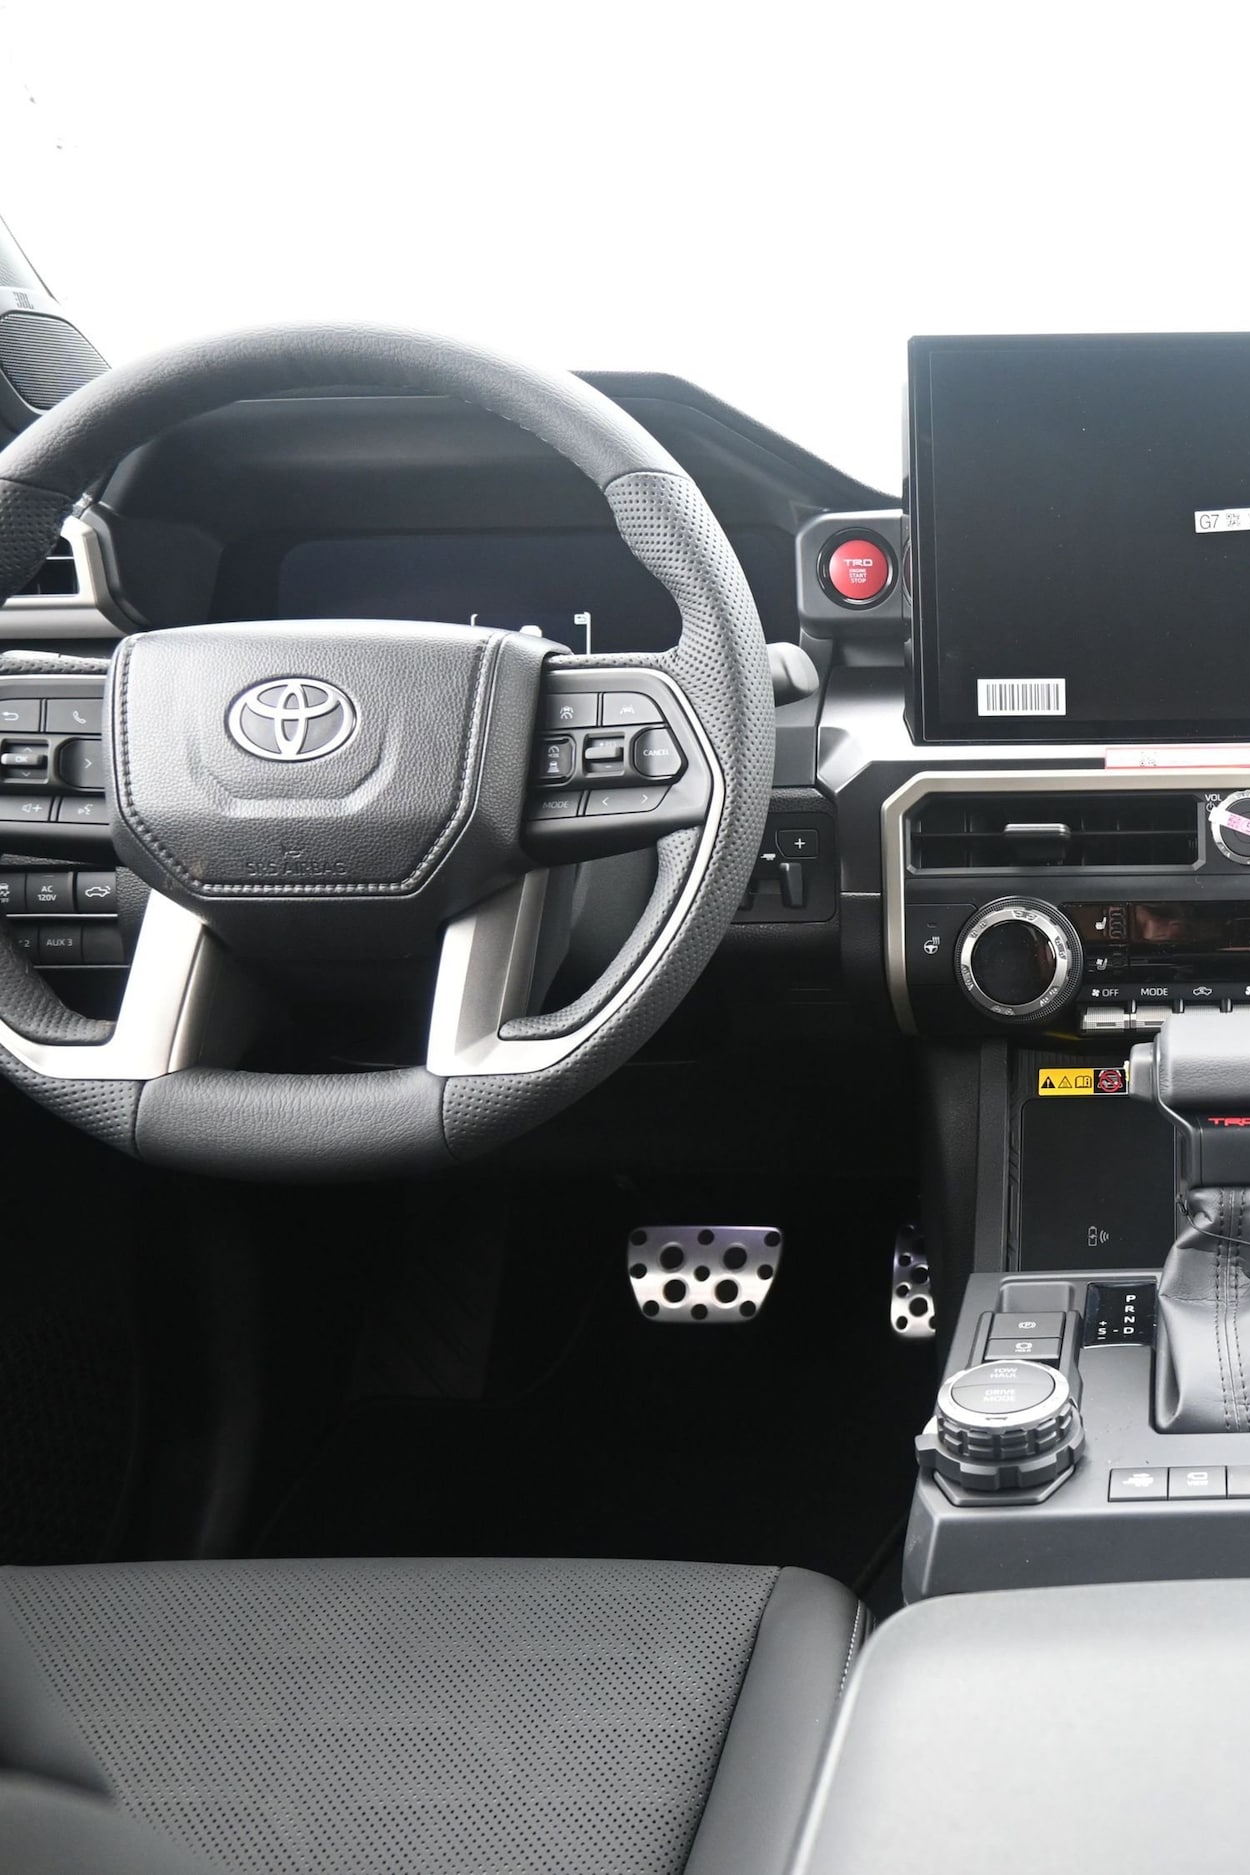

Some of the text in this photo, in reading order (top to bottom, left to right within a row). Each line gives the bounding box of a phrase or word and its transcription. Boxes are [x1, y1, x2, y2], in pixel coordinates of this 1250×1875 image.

[1199, 513, 1220, 530] G7
[843, 558, 873, 567] TRD
[1204, 793, 1222, 802] VOL
[542, 800, 569, 809] MODE
[41, 885, 54, 893] AC
[37, 894, 57, 902] 120V
[1102, 988, 1120, 997] OFF
[1140, 988, 1169, 997] MODE
[1125, 1294, 1137, 1303] P
[1124, 1305, 1136, 1313] R
[1124, 1316, 1136, 1324] N
[1097, 1326, 1135, 1335] S D
[984, 1388, 1017, 1396] DRIVE
